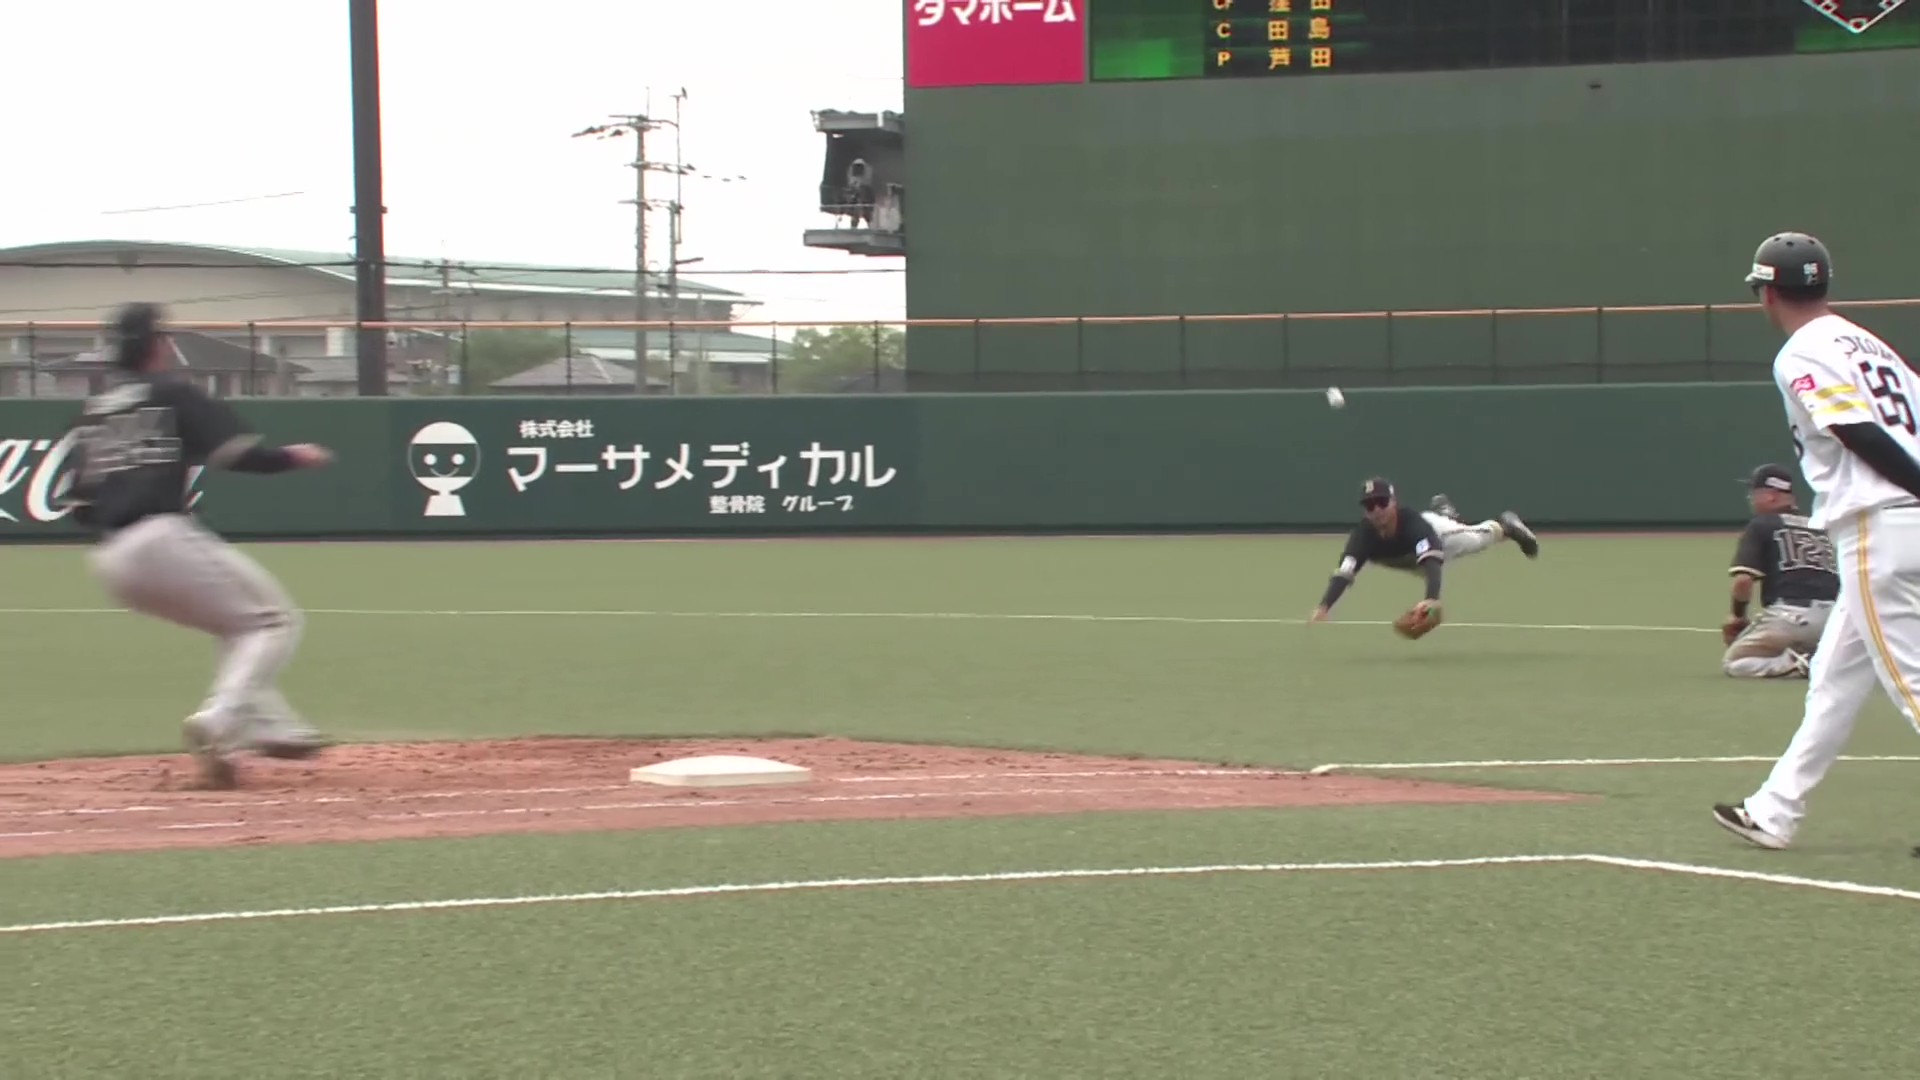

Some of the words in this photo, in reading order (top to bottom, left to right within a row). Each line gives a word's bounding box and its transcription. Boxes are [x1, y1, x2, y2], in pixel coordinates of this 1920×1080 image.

[914, 0, 1076, 26] タマホーム
[1216, 22, 1231, 38] C
[1217, 51, 1231, 66] P
[519, 419, 594, 438] 株式会社
[507, 442, 897, 492] マーサメディカル
[709, 495, 766, 514] 整骨院
